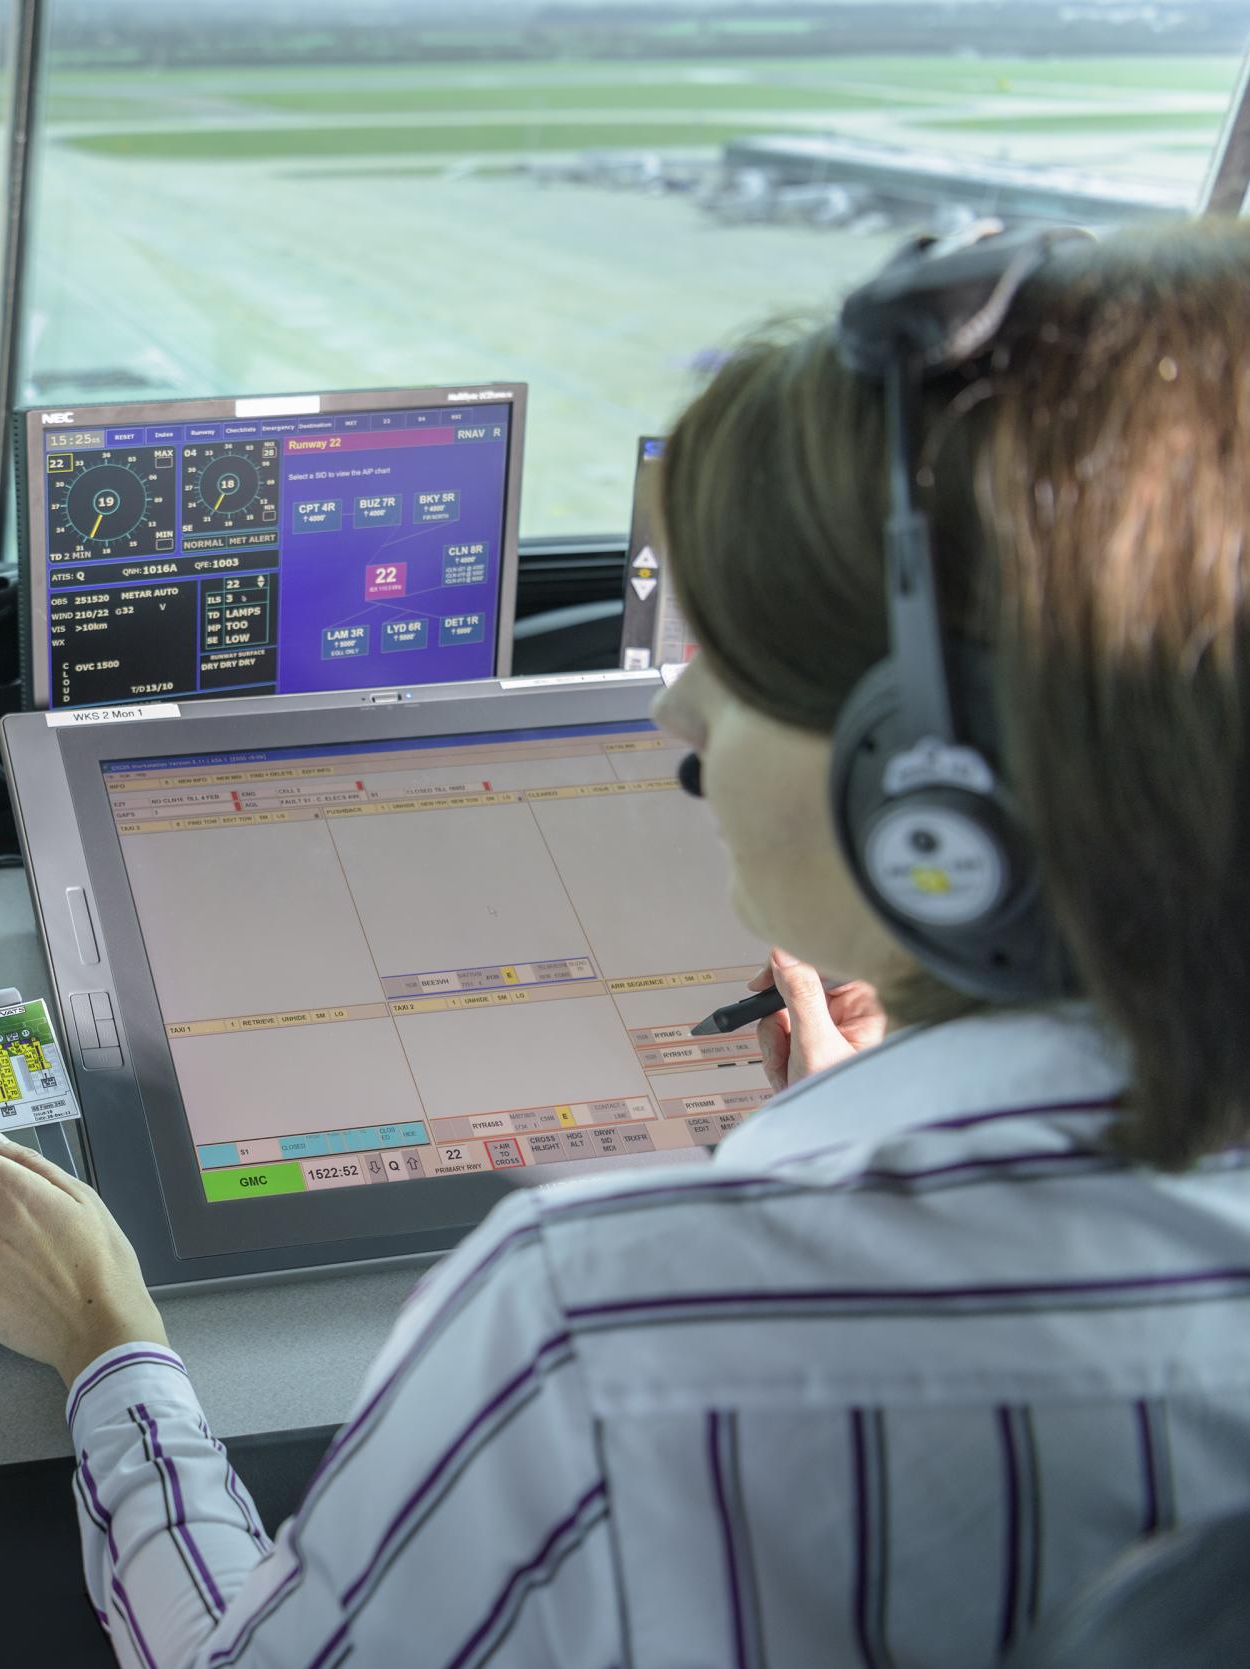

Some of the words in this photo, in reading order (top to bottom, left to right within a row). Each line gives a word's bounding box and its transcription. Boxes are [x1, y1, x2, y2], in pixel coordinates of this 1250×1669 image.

[41, 412, 74, 425] NEC
[457, 429, 486, 439] RNAV
[493, 427, 501, 437] R
[288, 439, 327, 450] Runway
[329, 438, 342, 448] 22
[49, 459, 64, 468] 22
[221, 479, 235, 489] 18
[97, 496, 115, 507] 19
[359, 499, 381, 509] BUZ
[382, 497, 396, 506] 7R
[419, 495, 440, 504] BKY
[441, 492, 455, 502] 5R
[298, 504, 319, 514] CPT
[321, 502, 336, 512] 4R
[155, 531, 174, 539] MIN
[229, 536, 247, 545] MET
[248, 534, 276, 543] ALERT
[183, 539, 224, 550] NORMAL
[448, 547, 468, 556] CLN
[470, 544, 483, 554] 8R
[50, 553, 62, 561] TD
[72, 551, 92, 560] MIN
[143, 563, 178, 575] 1016A
[213, 558, 239, 569] 1003
[76, 571, 85, 581] Q
[375, 567, 397, 584] 22
[226, 580, 240, 589] 22
[74, 594, 110, 605] 251520
[121, 591, 153, 600] METAR
[154, 588, 179, 597] AUTO
[206, 596, 222, 604] ILS
[226, 594, 233, 603] 3
[51, 611, 73, 620] WIND
[74, 608, 109, 620] 210/22
[225, 607, 262, 618] LAMPS
[225, 620, 248, 631] TOO
[444, 617, 464, 627] DET
[466, 615, 479, 625] 1R
[51, 625, 67, 633] VIS
[327, 629, 350, 640] LAM
[350, 627, 364, 638] 3R
[387, 624, 407, 634] LYD
[409, 622, 421, 631] 6R
[52, 639, 65, 647] WX
[225, 634, 250, 644] LOW
[74, 662, 95, 672] OVC
[96, 660, 120, 670] 1500
[201, 662, 219, 671] DRY
[220, 660, 237, 669] DRY
[238, 658, 256, 667] DRY
[73, 710, 100, 721] WKS
[102, 711, 109, 719] 2
[112, 709, 135, 719] Mon
[170, 1026, 185, 1034] TAXI
[242, 1017, 276, 1026] RETRIEVE
[688, 1118, 711, 1127] LOCAL
[694, 1125, 710, 1133] EDIT
[529, 1135, 555, 1144] CROSS
[566, 1131, 583, 1140] HDG
[570, 1139, 584, 1148] ALT
[446, 1149, 462, 1160] 22
[495, 1157, 519, 1166] CROSS
[239, 1175, 268, 1187] GMC
[308, 1165, 359, 1181] 1522:52
[388, 1160, 399, 1171] Q
[435, 1166, 465, 1174] PRIMARY
[466, 1163, 482, 1171] RWY
